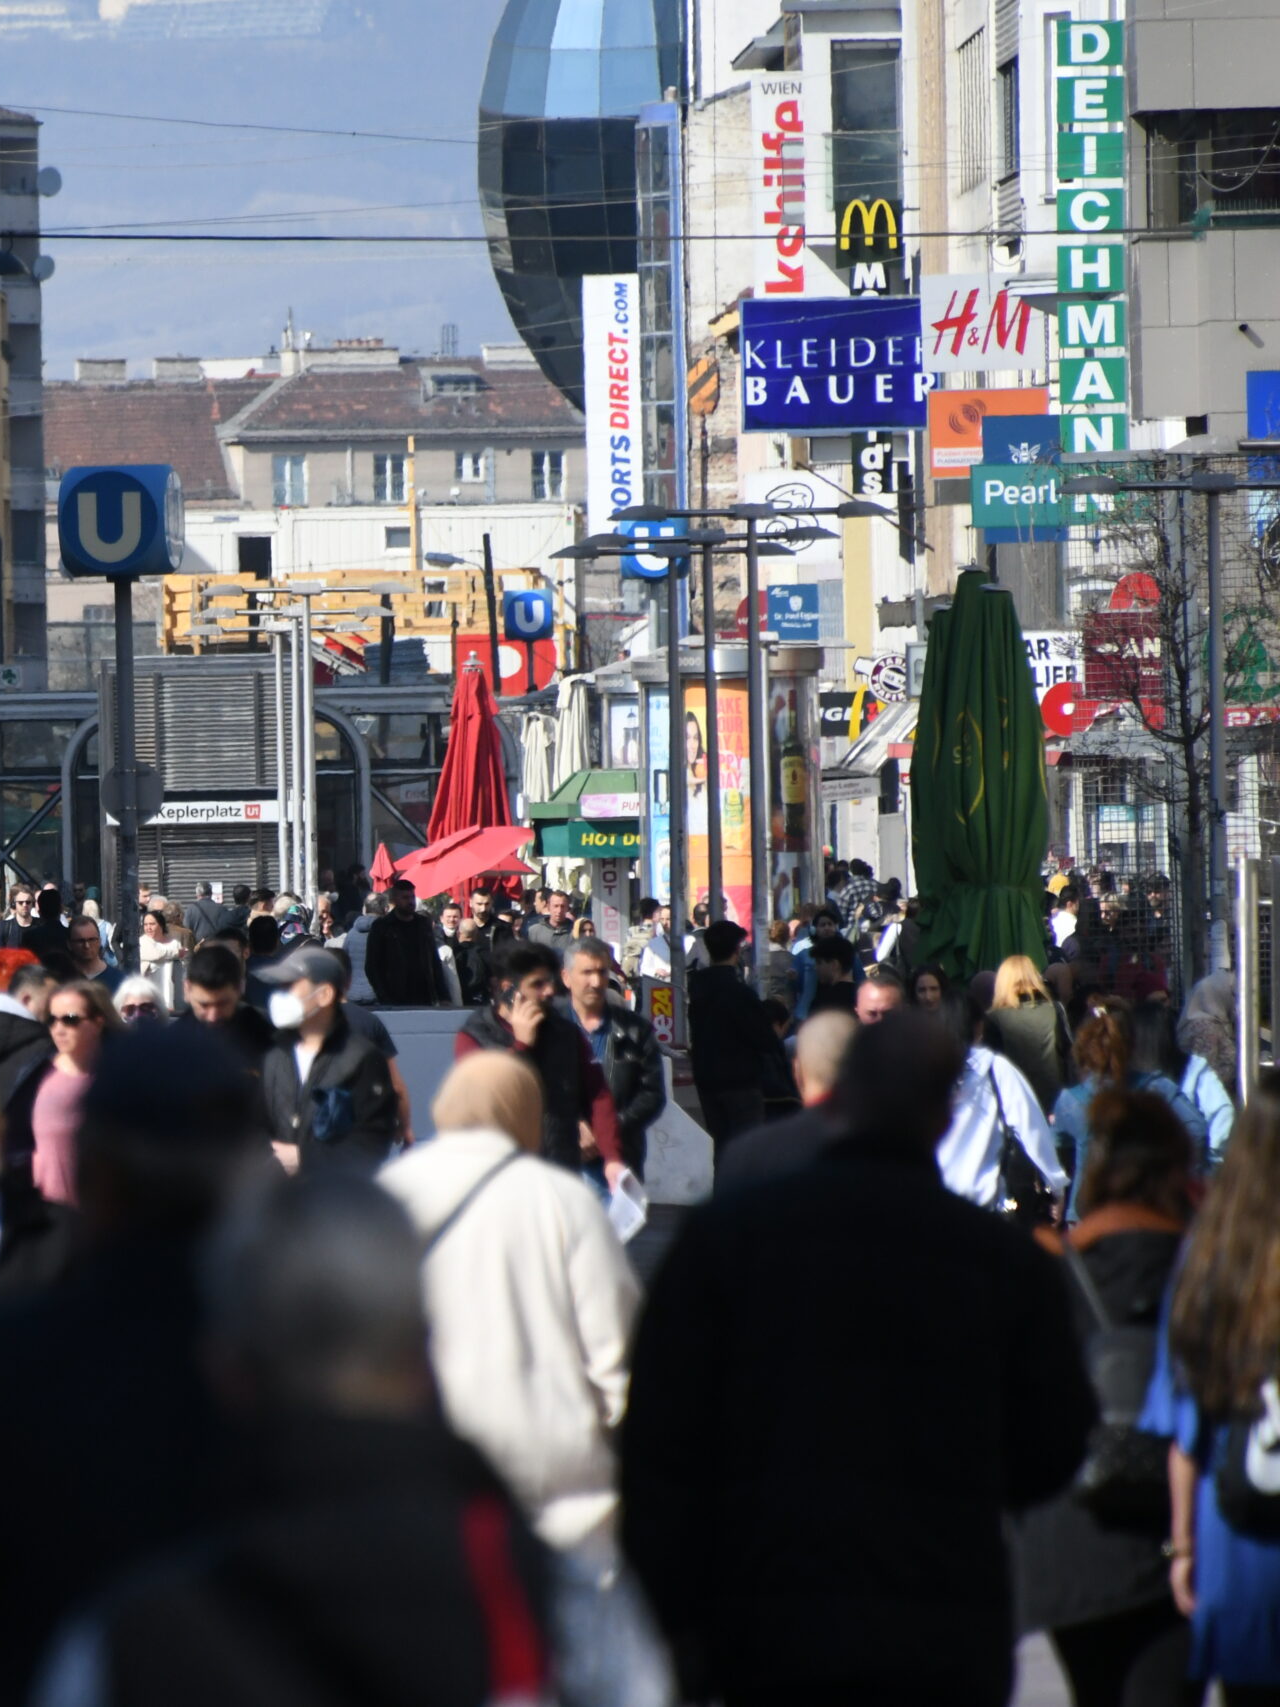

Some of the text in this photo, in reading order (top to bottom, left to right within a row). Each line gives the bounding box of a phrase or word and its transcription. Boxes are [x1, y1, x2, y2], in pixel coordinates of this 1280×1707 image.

[761, 81, 803, 95] WIEN
[931, 288, 1032, 356] H&M
[746, 374, 936, 406] BAUER
[610, 435, 632, 516] ORTS
[985, 479, 1062, 505] Pearl
[78, 491, 141, 563] U
[514, 600, 545, 633] U
[156, 805, 260, 822] Keplerplatz U1
[581, 833, 617, 847] HOT
[653, 987, 673, 1044] oe24
